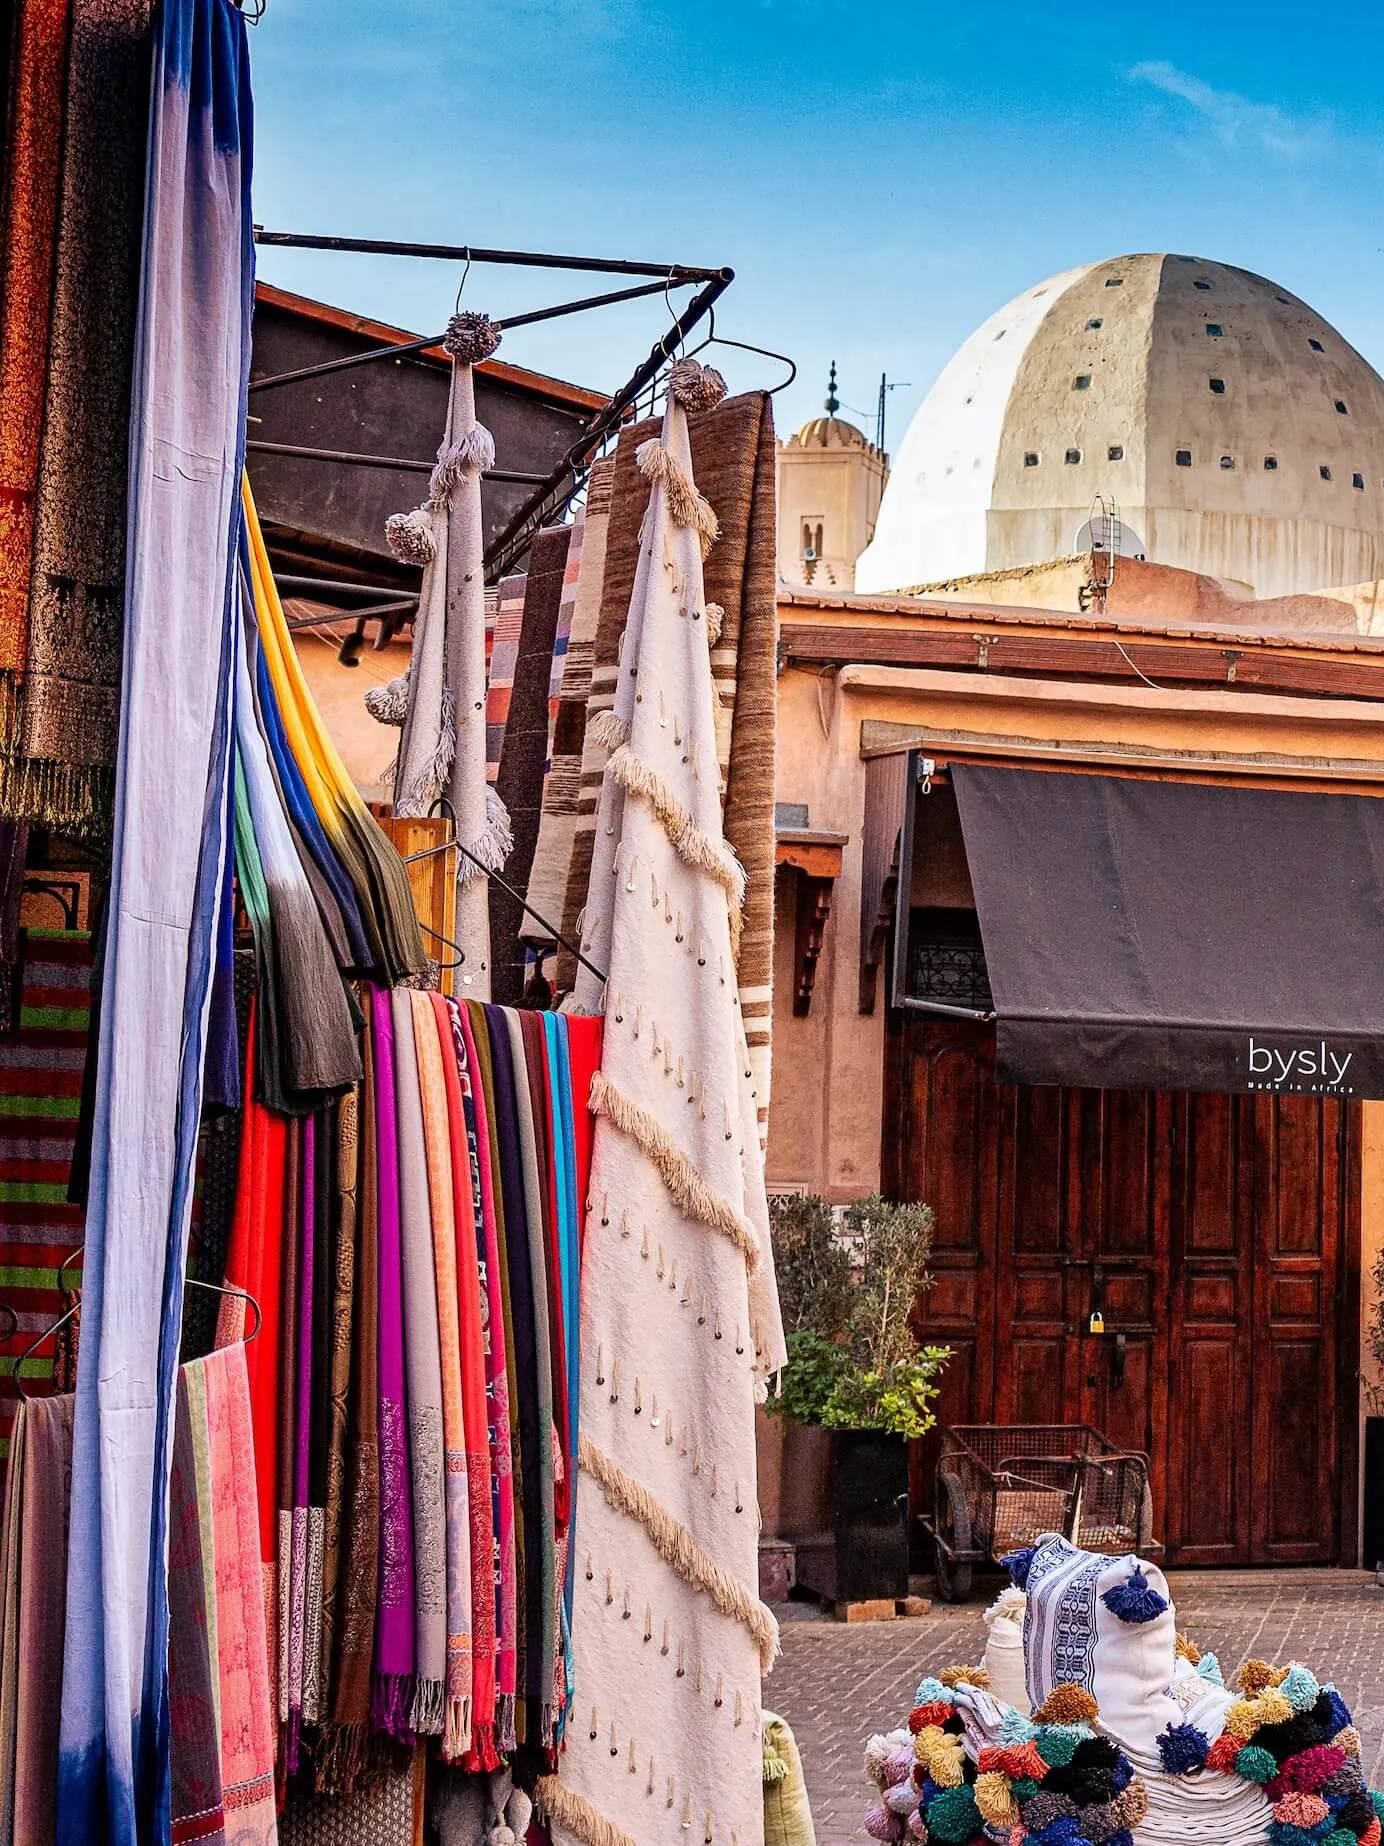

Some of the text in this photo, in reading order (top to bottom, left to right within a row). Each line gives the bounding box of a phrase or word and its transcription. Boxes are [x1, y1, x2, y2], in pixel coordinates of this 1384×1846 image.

[1249, 1037, 1353, 1085] bysly
[1247, 1081, 1354, 1094] Made in Africa
